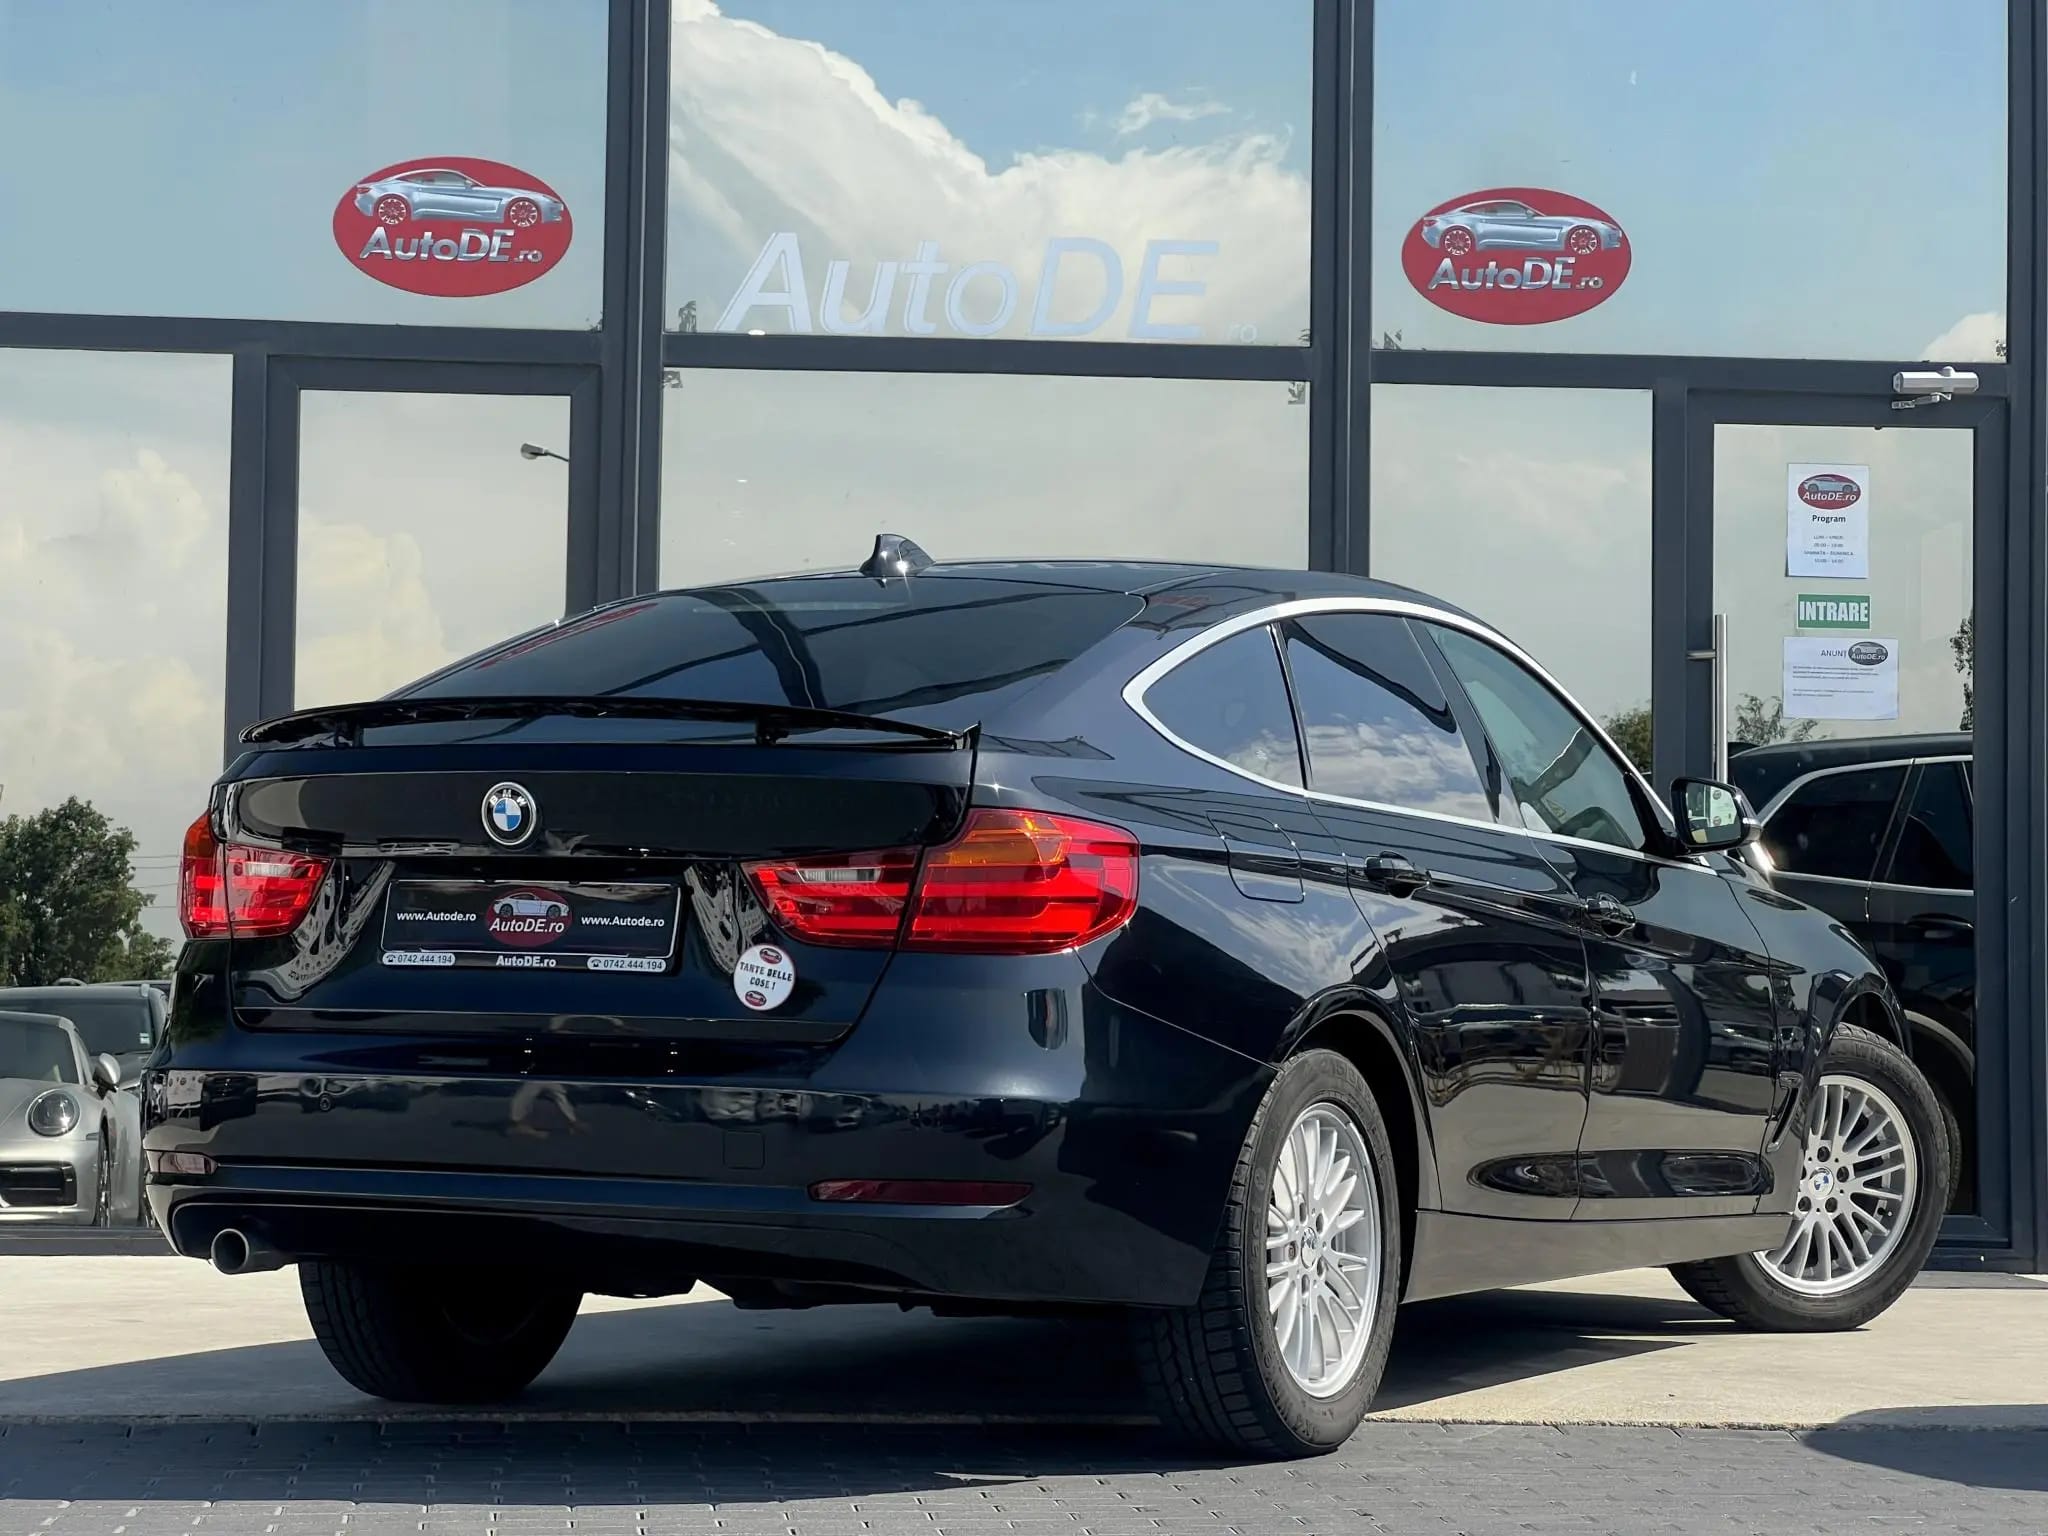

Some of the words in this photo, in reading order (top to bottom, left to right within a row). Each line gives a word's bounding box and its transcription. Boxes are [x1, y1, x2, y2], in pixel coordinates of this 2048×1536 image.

[359, 226, 543, 263] AutoDE.ro
[1427, 257, 1604, 290] AutoDE.ro
[1803, 492, 1856, 501] AutoDE.ro
[1812, 515, 1846, 523] Program
[1800, 601, 1868, 621] INTRARE
[490, 789, 527, 806] BMW
[397, 911, 477, 921] www.Autode.ro
[581, 916, 665, 927] www.Autode.ro
[490, 919, 565, 933] AutoDE.ro
[496, 956, 556, 967] AutoDE.ro
[740, 962, 765, 975] TANTE
[750, 977, 770, 989] COSE
